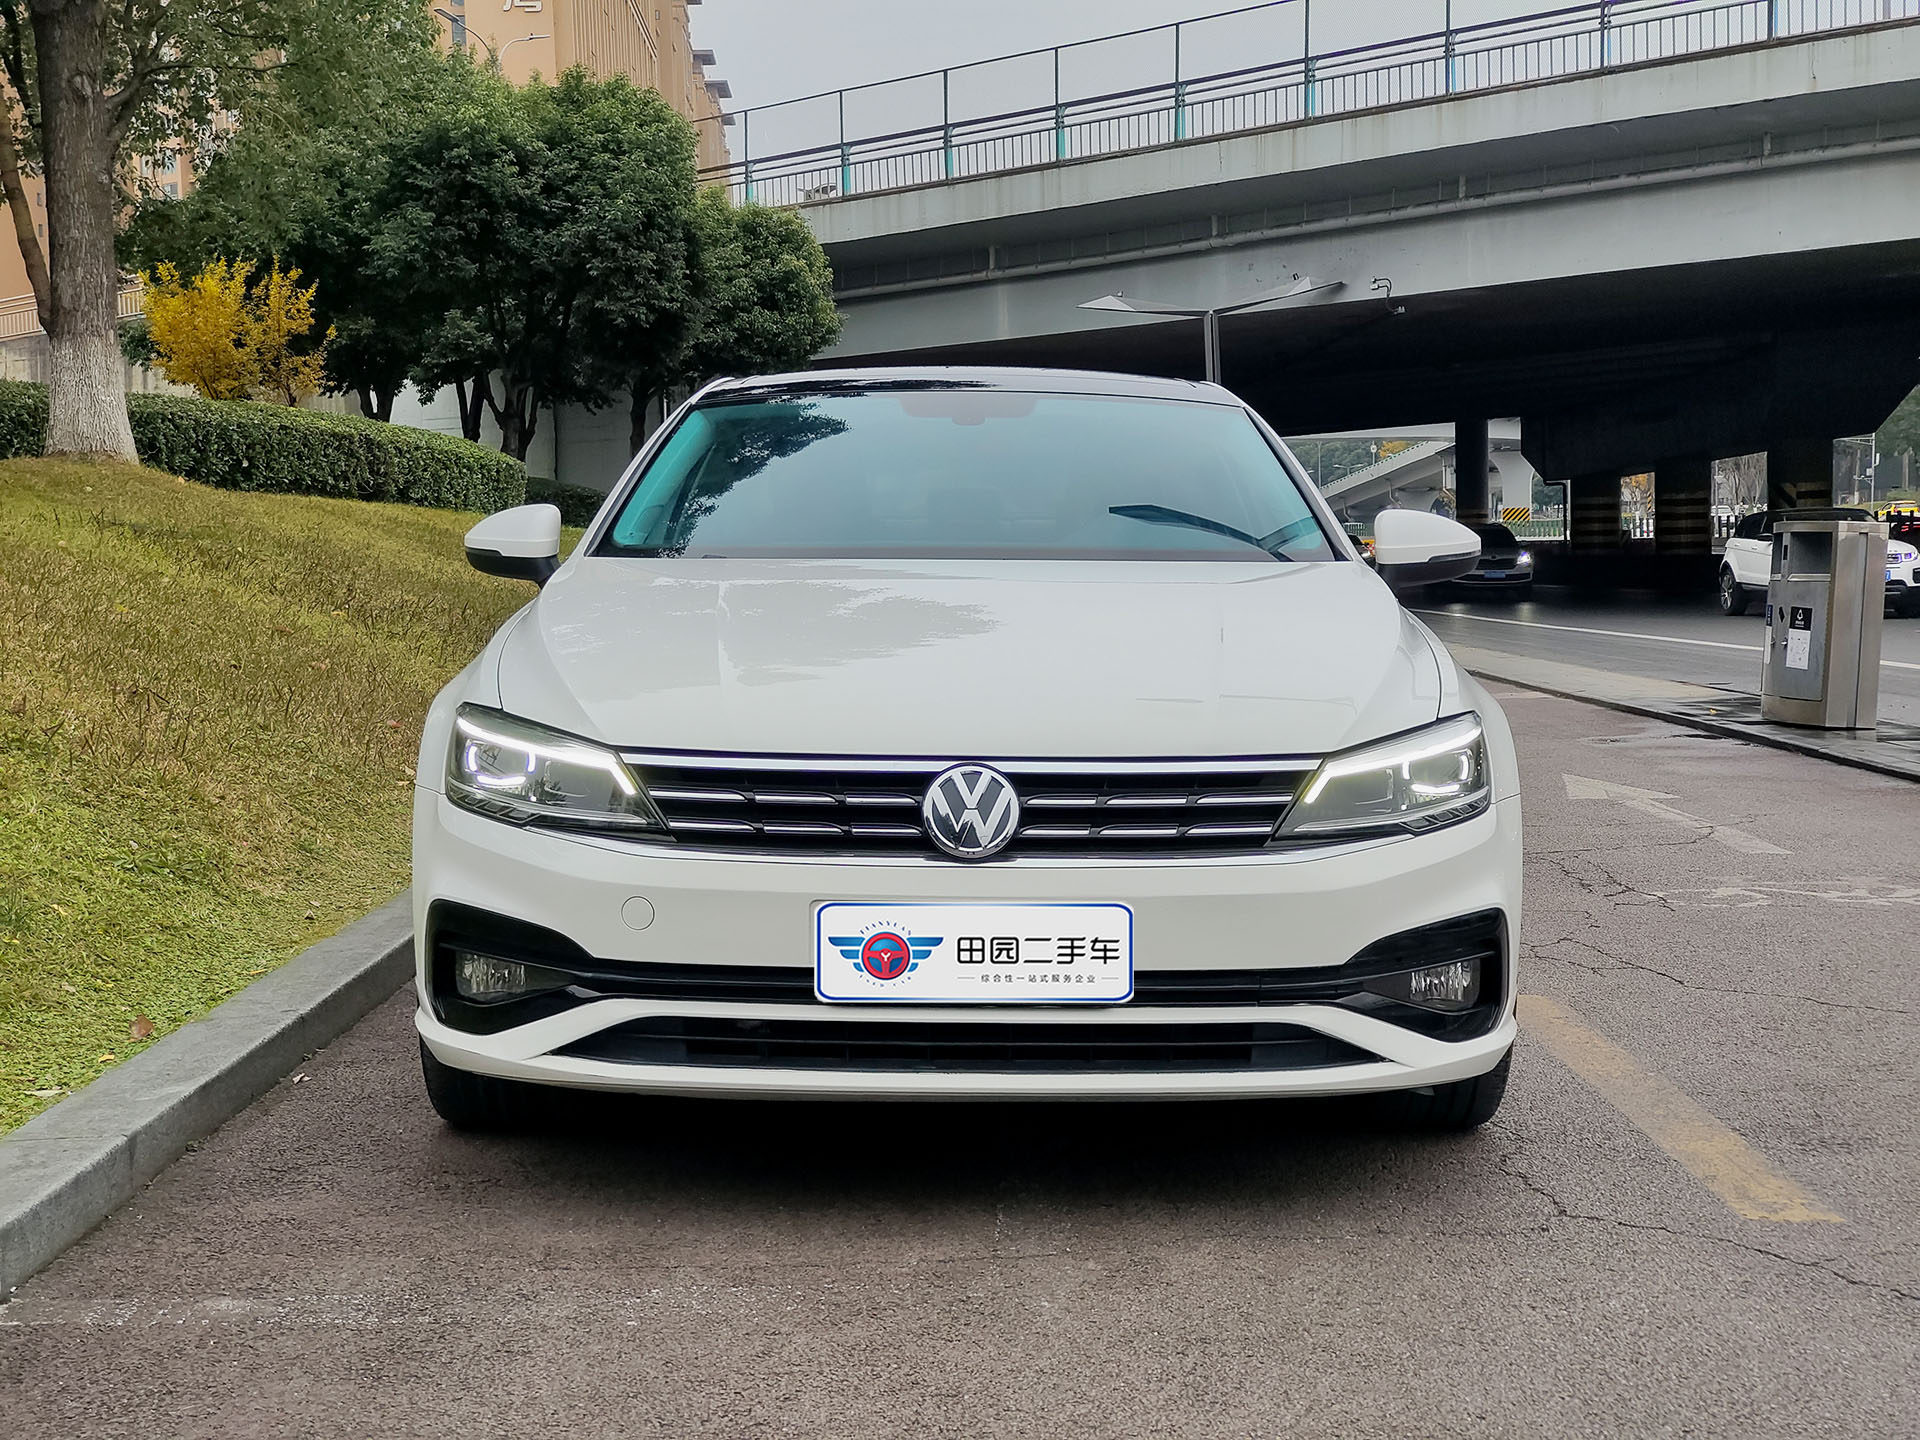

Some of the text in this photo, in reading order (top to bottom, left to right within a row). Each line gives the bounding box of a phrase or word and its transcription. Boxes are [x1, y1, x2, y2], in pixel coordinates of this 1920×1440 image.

[928, 766, 1015, 853] VW
[957, 937, 1120, 965] 田园二手车
[981, 974, 1096, 983] 综合性一站式服务企业
